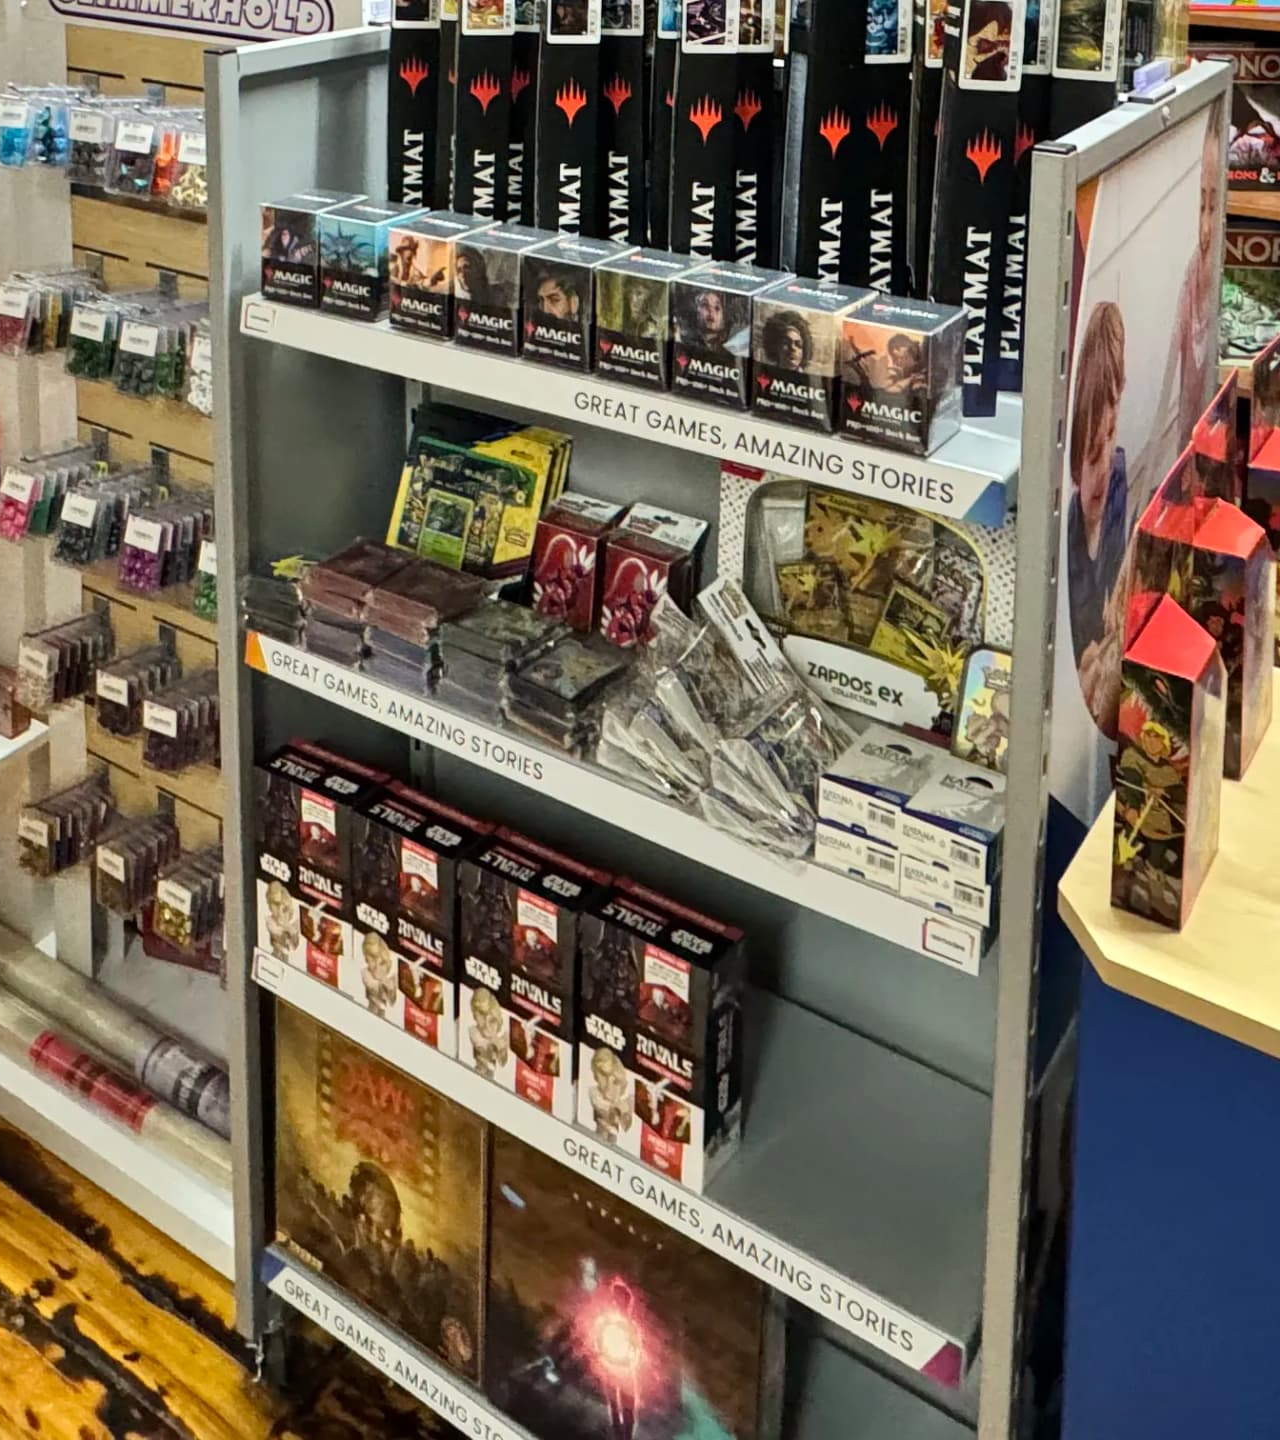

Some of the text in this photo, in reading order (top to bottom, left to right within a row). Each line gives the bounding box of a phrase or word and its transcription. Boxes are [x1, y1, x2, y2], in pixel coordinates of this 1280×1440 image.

[272, 268, 313, 286] MAGIC
[332, 280, 371, 297] MAGIC
[400, 297, 442, 315] MAGIC
[468, 312, 513, 330] MAGIC
[962, 226, 992, 386] PLAYMAT
[535, 325, 582, 345] MAGIC
[610, 344, 661, 364] MAGIC
[686, 359, 740, 381] MAGIC
[771, 380, 826, 401] MAGIC
[861, 401, 923, 424] MAGIC
[574, 392, 640, 425] GREAT
[646, 408, 727, 450] GAMES,
[734, 432, 844, 475] AMAZING
[852, 460, 955, 504] STORIES
[807, 662, 903, 707] ZAPDOS ex
[831, 686, 878, 708] COLLECTION
[271, 650, 545, 781] GREAT GAMES, AMAZING STORIES
[298, 866, 343, 900] RIVALS
[480, 849, 535, 883] RIVALS
[398, 918, 444, 956] RIVALS
[603, 902, 663, 938] RIVALS
[511, 977, 562, 1015] RIVALS
[636, 1033, 694, 1078] RIVALS
[562, 1137, 625, 1186] GREAT
[629, 1166, 707, 1236] GAMES,
[712, 1219, 813, 1292] AMAZING
[818, 1282, 915, 1352] STORIES
[284, 1279, 468, 1423] GREAT GAMES, AMAZING
